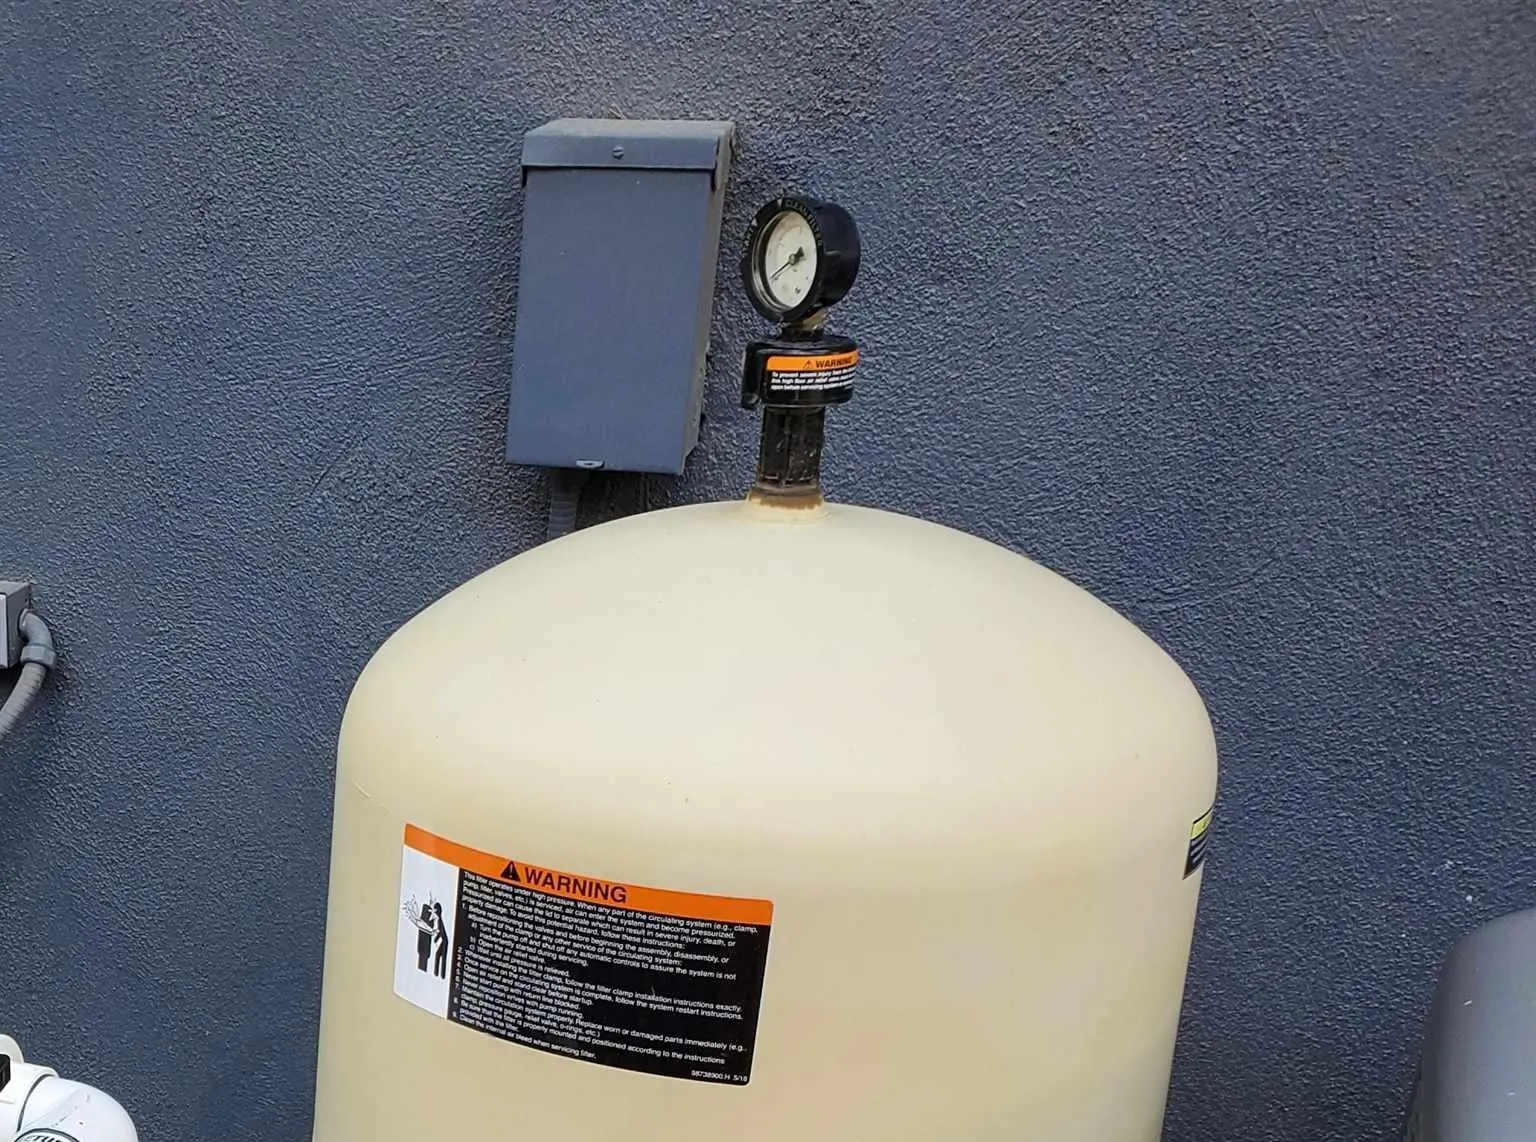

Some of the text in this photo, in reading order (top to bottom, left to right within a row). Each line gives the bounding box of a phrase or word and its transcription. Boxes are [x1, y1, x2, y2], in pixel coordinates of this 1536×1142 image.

[524, 867, 627, 904] WARNING
[588, 911, 605, 920] enter
[619, 917, 644, 928] system
[645, 921, 659, 929] and
[660, 924, 689, 933] become
[597, 906, 610, 914] any
[611, 908, 625, 917] part
[647, 914, 684, 926] circulating
[685, 919, 712, 929] system
[590, 920, 610, 929] which
[625, 926, 645, 935] result
[654, 931, 678, 940] severe
[600, 930, 620, 939] follow
[621, 933, 640, 942] these
[590, 936, 623, 949] beginning
[579, 950, 611, 962] automatic
[612, 957, 640, 967] controls
[649, 964, 673, 972] assure
[675, 966, 687, 974] the
[688, 968, 714, 978] system
[605, 947, 616, 955] the
[617, 949, 653, 962] circulating
[584, 982, 595, 990] the
[596, 985, 610, 993] filter
[612, 988, 633, 998] clamp
[634, 992, 672, 1003] installation
[673, 997, 714, 1008] instructions
[615, 996, 634, 1005] follow
[636, 999, 647, 1007] the
[648, 1001, 674, 1012] system
[675, 1005, 699, 1014] restart
[575, 1018, 602, 1031] Replace
[603, 1025, 620, 1033] worn
[630, 1029, 663, 1041] damaged
[664, 1035, 683, 1044] parts
[684, 1037, 727, 1049] immediately
[585, 1028, 600, 1038] etc.)
[577, 1034, 590, 1042] and
[591, 1037, 626, 1050] positioned
[627, 1044, 661, 1056] according
[683, 1053, 725, 1063] instructions
